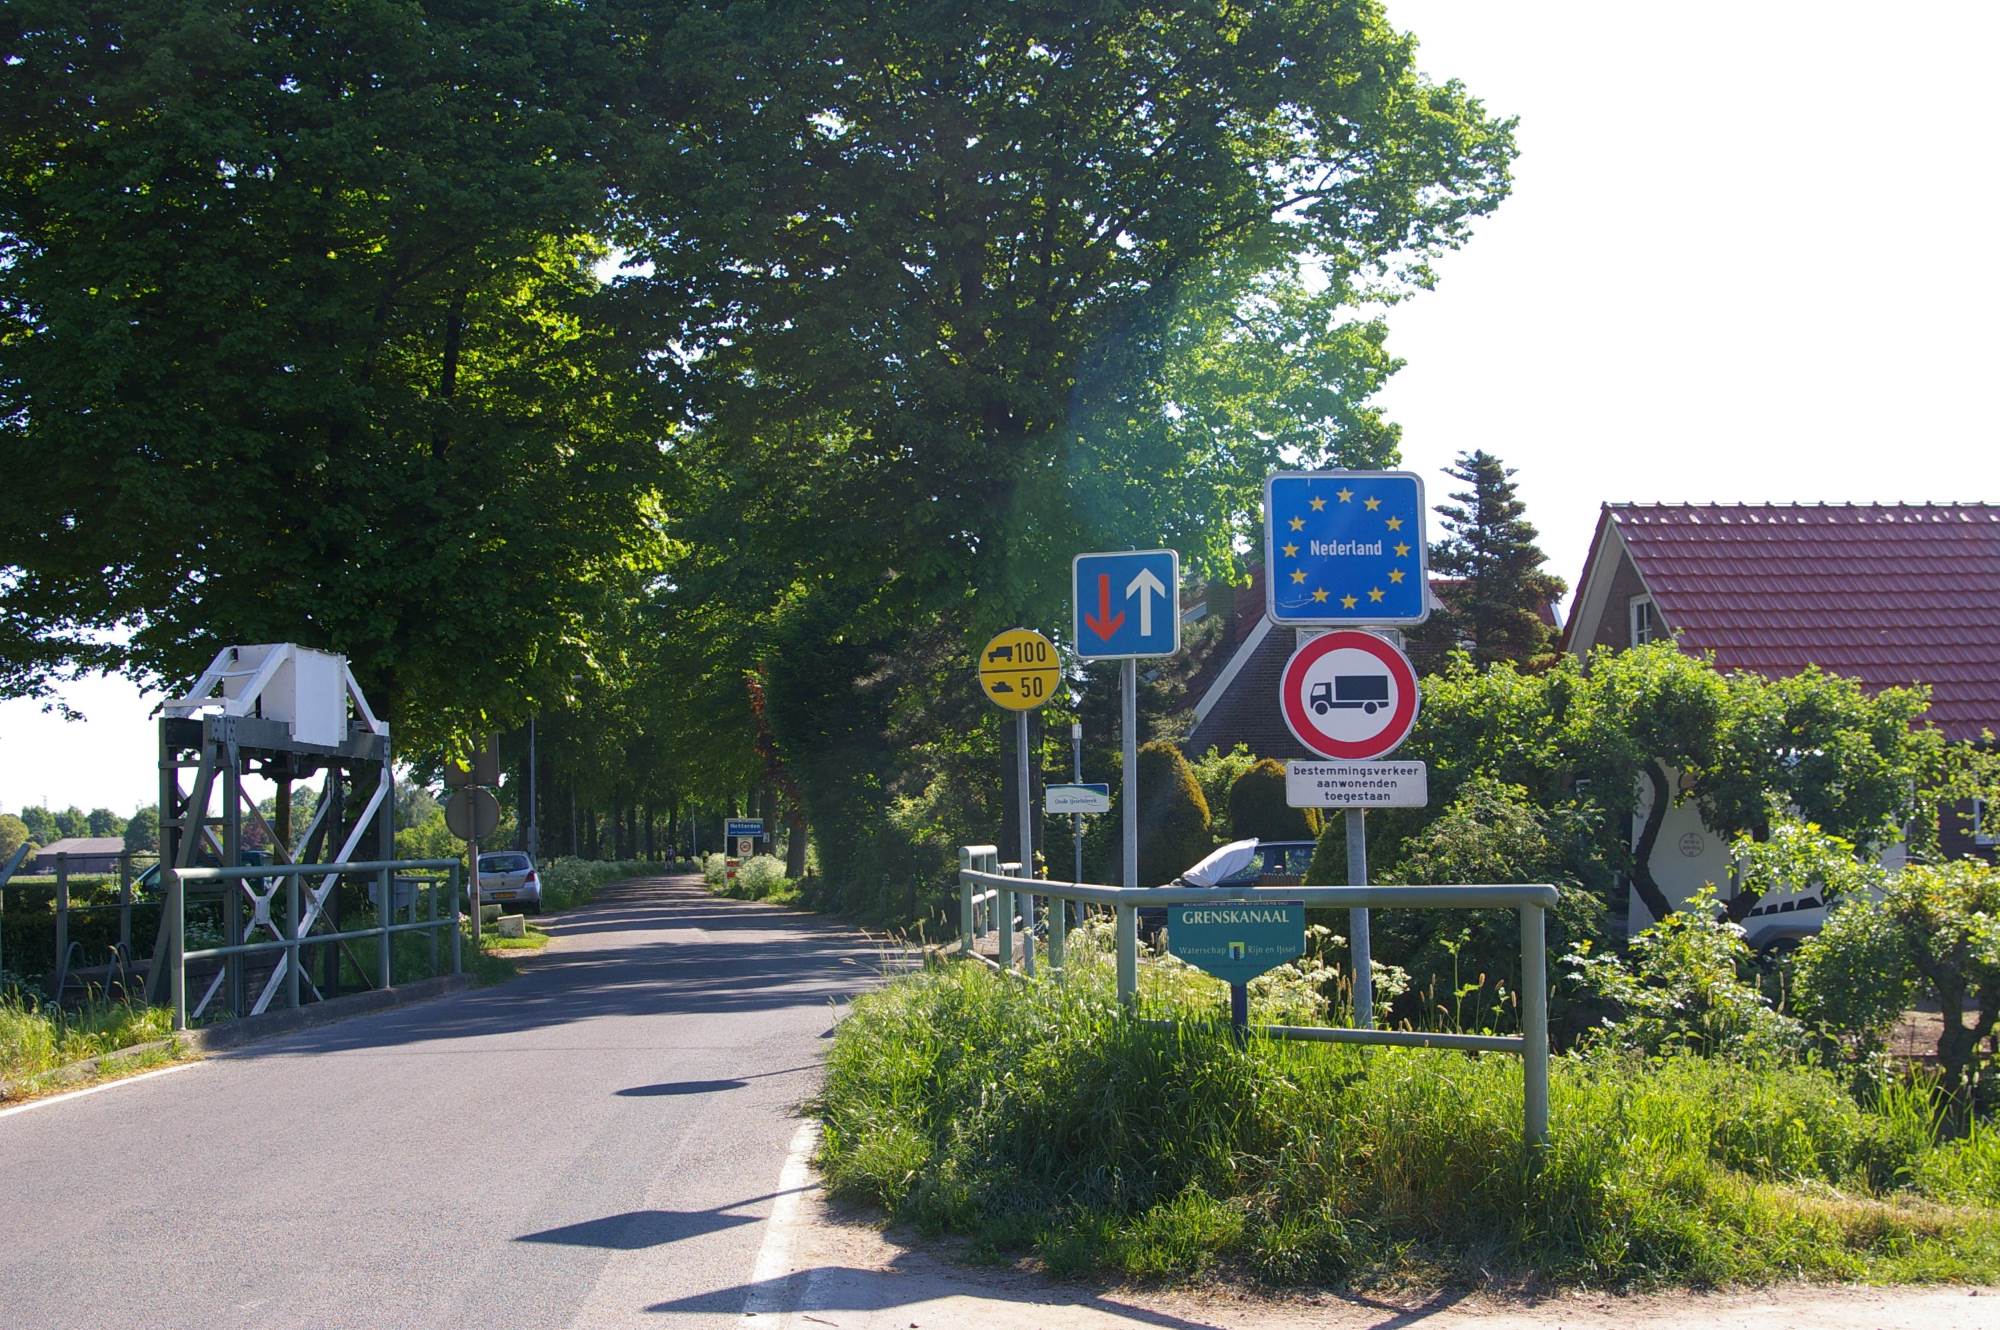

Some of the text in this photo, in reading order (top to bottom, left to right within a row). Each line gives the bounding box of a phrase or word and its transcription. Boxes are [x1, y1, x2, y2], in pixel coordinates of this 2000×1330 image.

[1310, 539, 1382, 556] Nederland
[1014, 642, 1046, 663] 100
[1021, 677, 1042, 697] 50
[1293, 766, 1418, 778] bestemmingsverkeer
[1317, 779, 1397, 788] aanwonenden
[1325, 791, 1391, 803] toegestaan
[1182, 910, 1289, 924] GRENSKANAAL
[1180, 946, 1226, 957] Waterschap
[1248, 945, 1263, 956] Rijn
